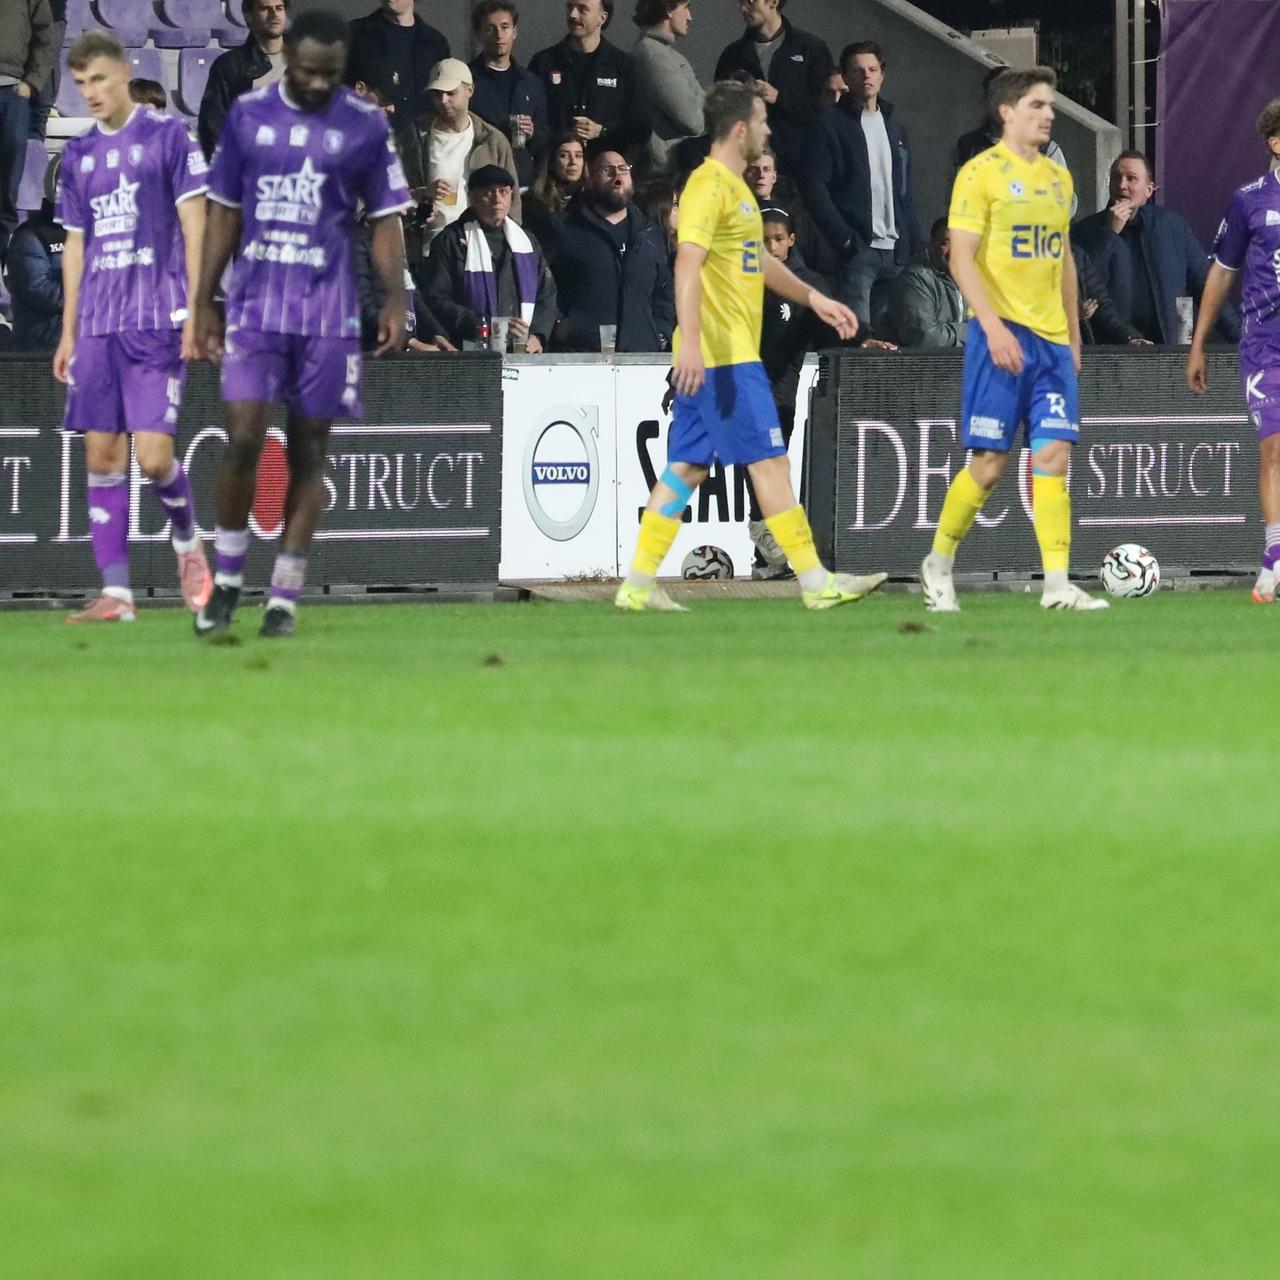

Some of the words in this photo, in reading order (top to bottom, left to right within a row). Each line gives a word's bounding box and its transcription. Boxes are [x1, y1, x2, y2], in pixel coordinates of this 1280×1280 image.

[1011, 224, 1063, 259] Elio
[534, 465, 589, 481] VOLVO
[1086, 441, 1241, 499] STRUCT
